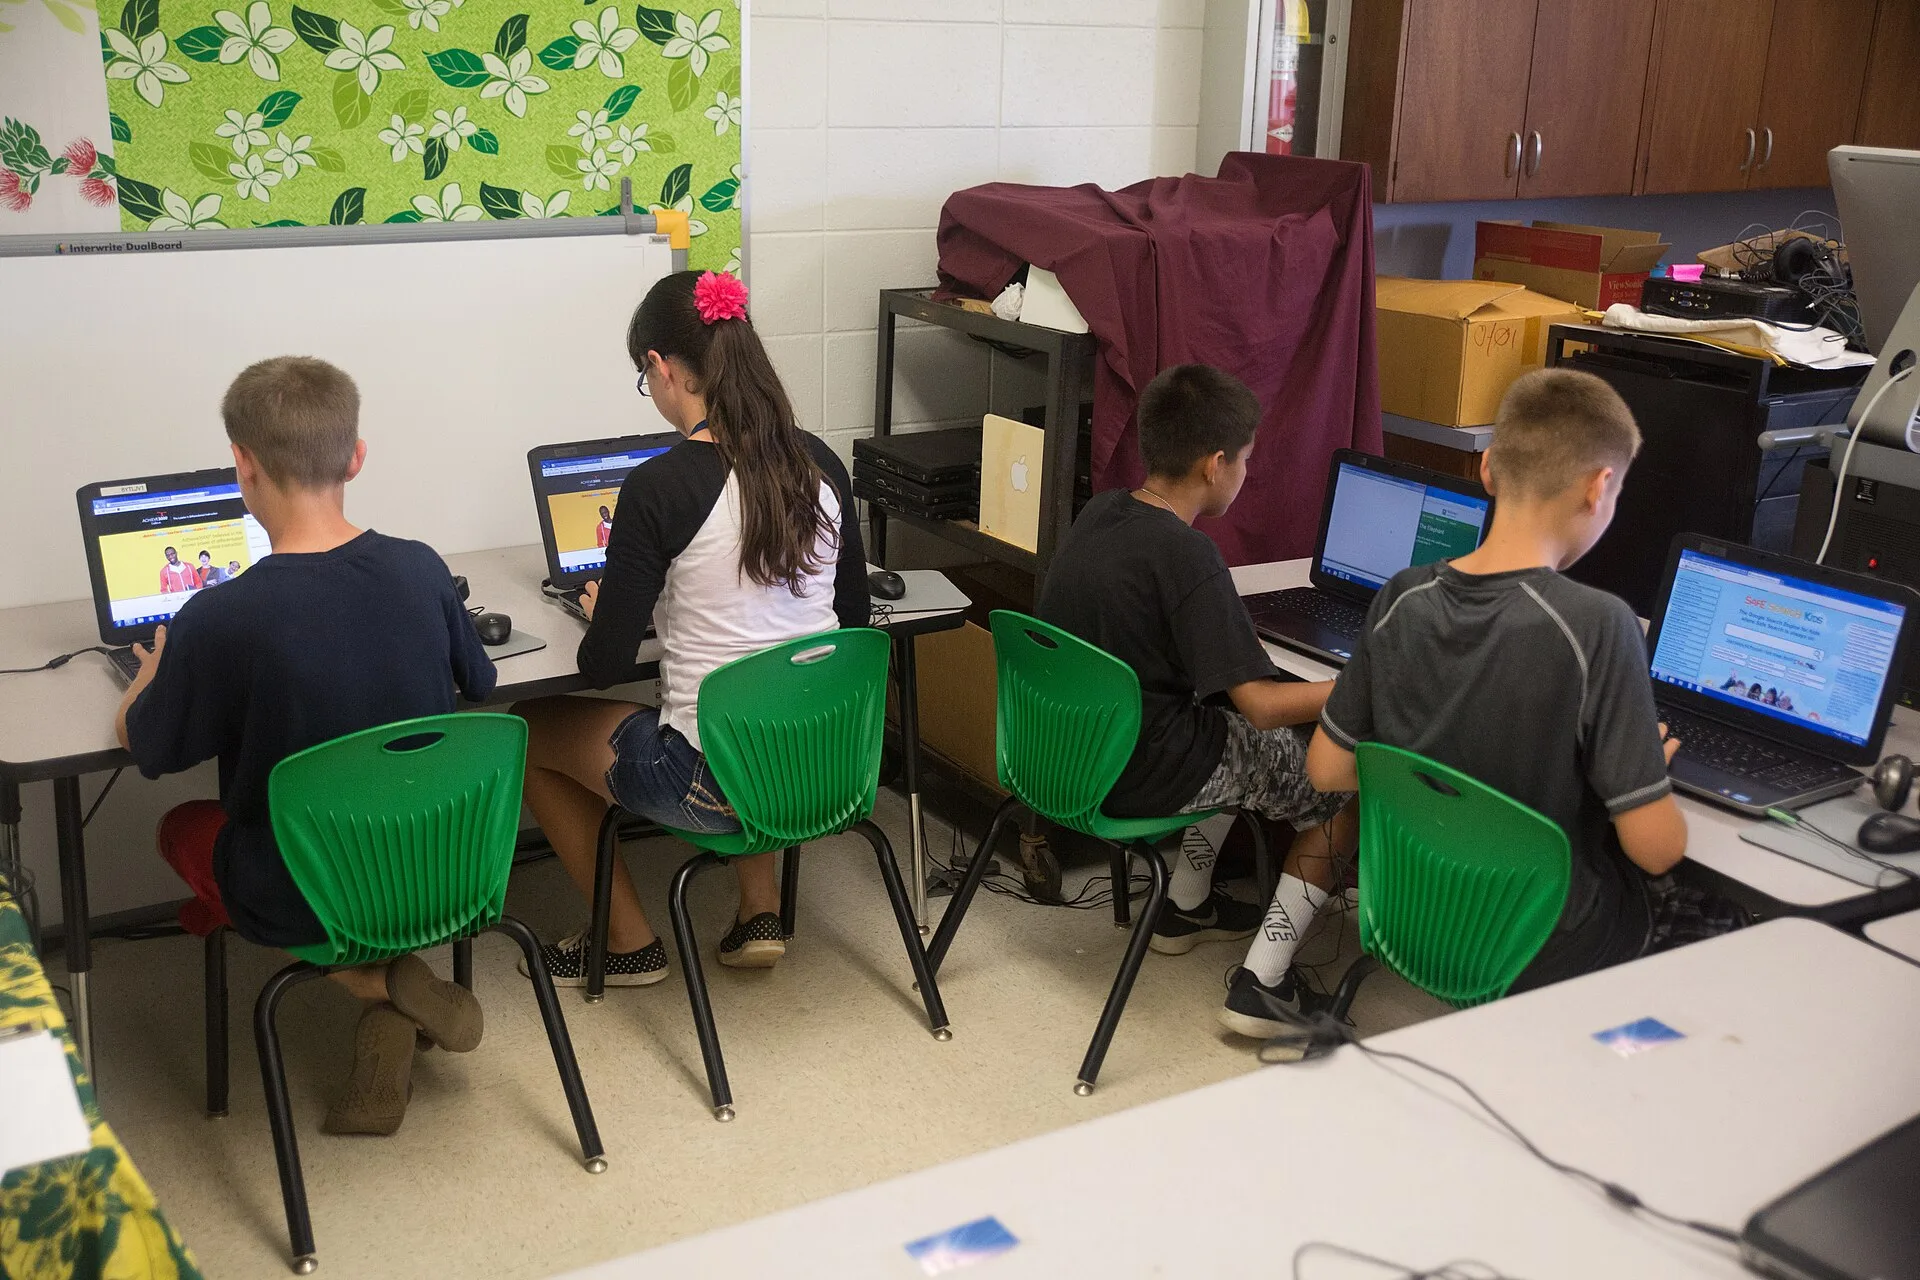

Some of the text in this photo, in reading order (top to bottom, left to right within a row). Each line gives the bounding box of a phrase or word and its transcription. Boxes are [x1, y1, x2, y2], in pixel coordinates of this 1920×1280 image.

[70, 240, 183, 253] Interwrite DualBoard
[1182, 825, 1217, 871] NIKE
